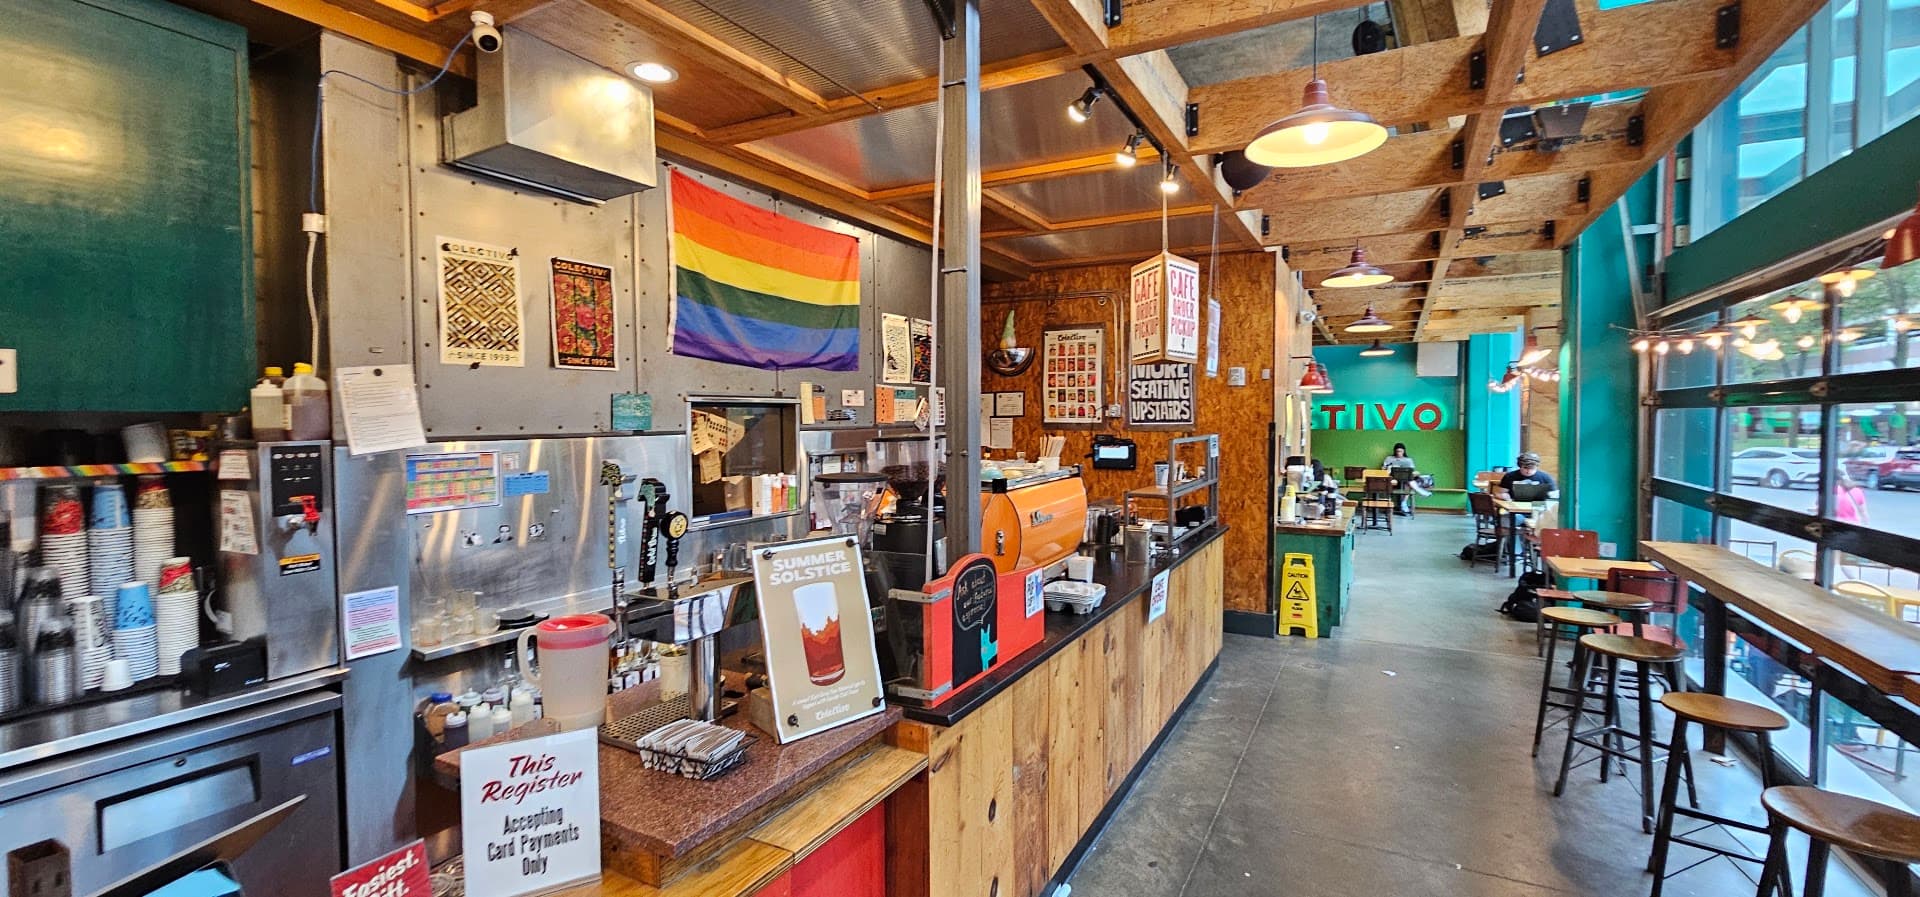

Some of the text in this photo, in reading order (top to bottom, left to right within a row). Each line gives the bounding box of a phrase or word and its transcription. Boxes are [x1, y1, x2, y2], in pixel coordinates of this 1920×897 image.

[1134, 270, 1159, 303] CAFE
[1170, 269, 1196, 301] CAFE
[1136, 298, 1158, 321] ORDER
[1172, 298, 1195, 320] ORDER
[1134, 316, 1159, 341] PICKUP
[1170, 317, 1196, 338] PICKUP
[1131, 363, 1190, 379] MORE
[1311, 402, 1442, 431] TIVO
[769, 561, 852, 586] SOLSTICE
[772, 550, 847, 572] SUMMER
[509, 753, 557, 778] This
[481, 770, 583, 805] Register
[503, 806, 563, 835] Accepting
[487, 823, 580, 862] Card Payments
[342, 849, 420, 897] Easiest.
[522, 853, 548, 876] Only
